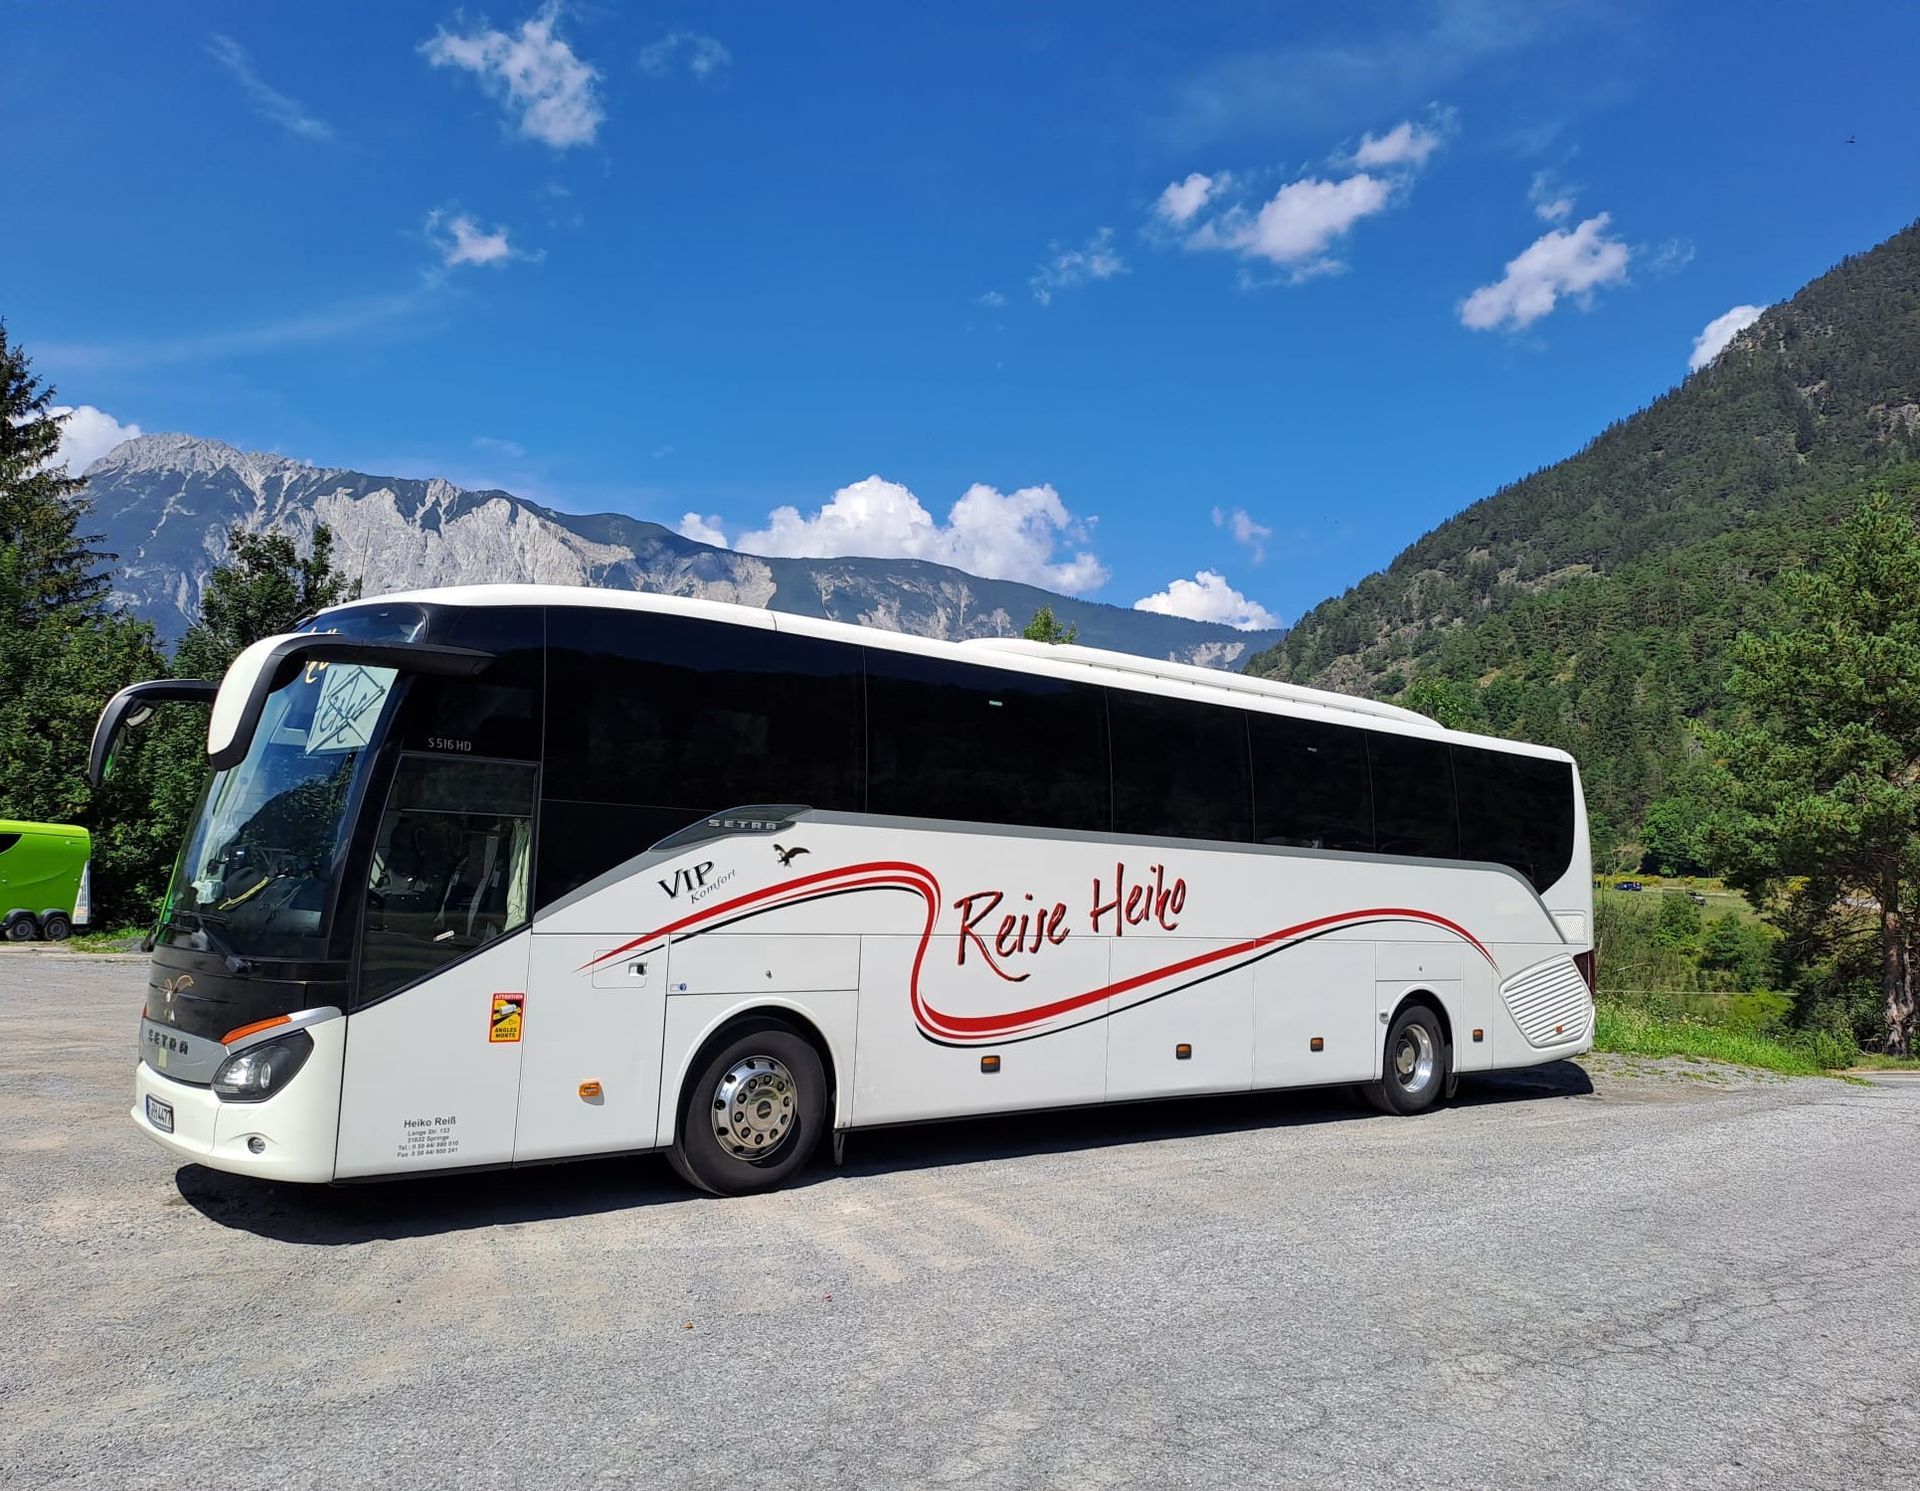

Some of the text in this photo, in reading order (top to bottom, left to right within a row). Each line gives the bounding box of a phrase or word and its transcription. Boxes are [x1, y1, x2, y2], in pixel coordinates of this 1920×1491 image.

[428, 737, 472, 751] S 516 HD
[708, 819, 777, 830] SETRA
[657, 860, 715, 899] VIP
[690, 869, 736, 905] Komfort
[953, 862, 1187, 983] Reise Heiko
[148, 1029, 189, 1055] SETRA
[403, 1115, 456, 1128] Heiko Reiß
